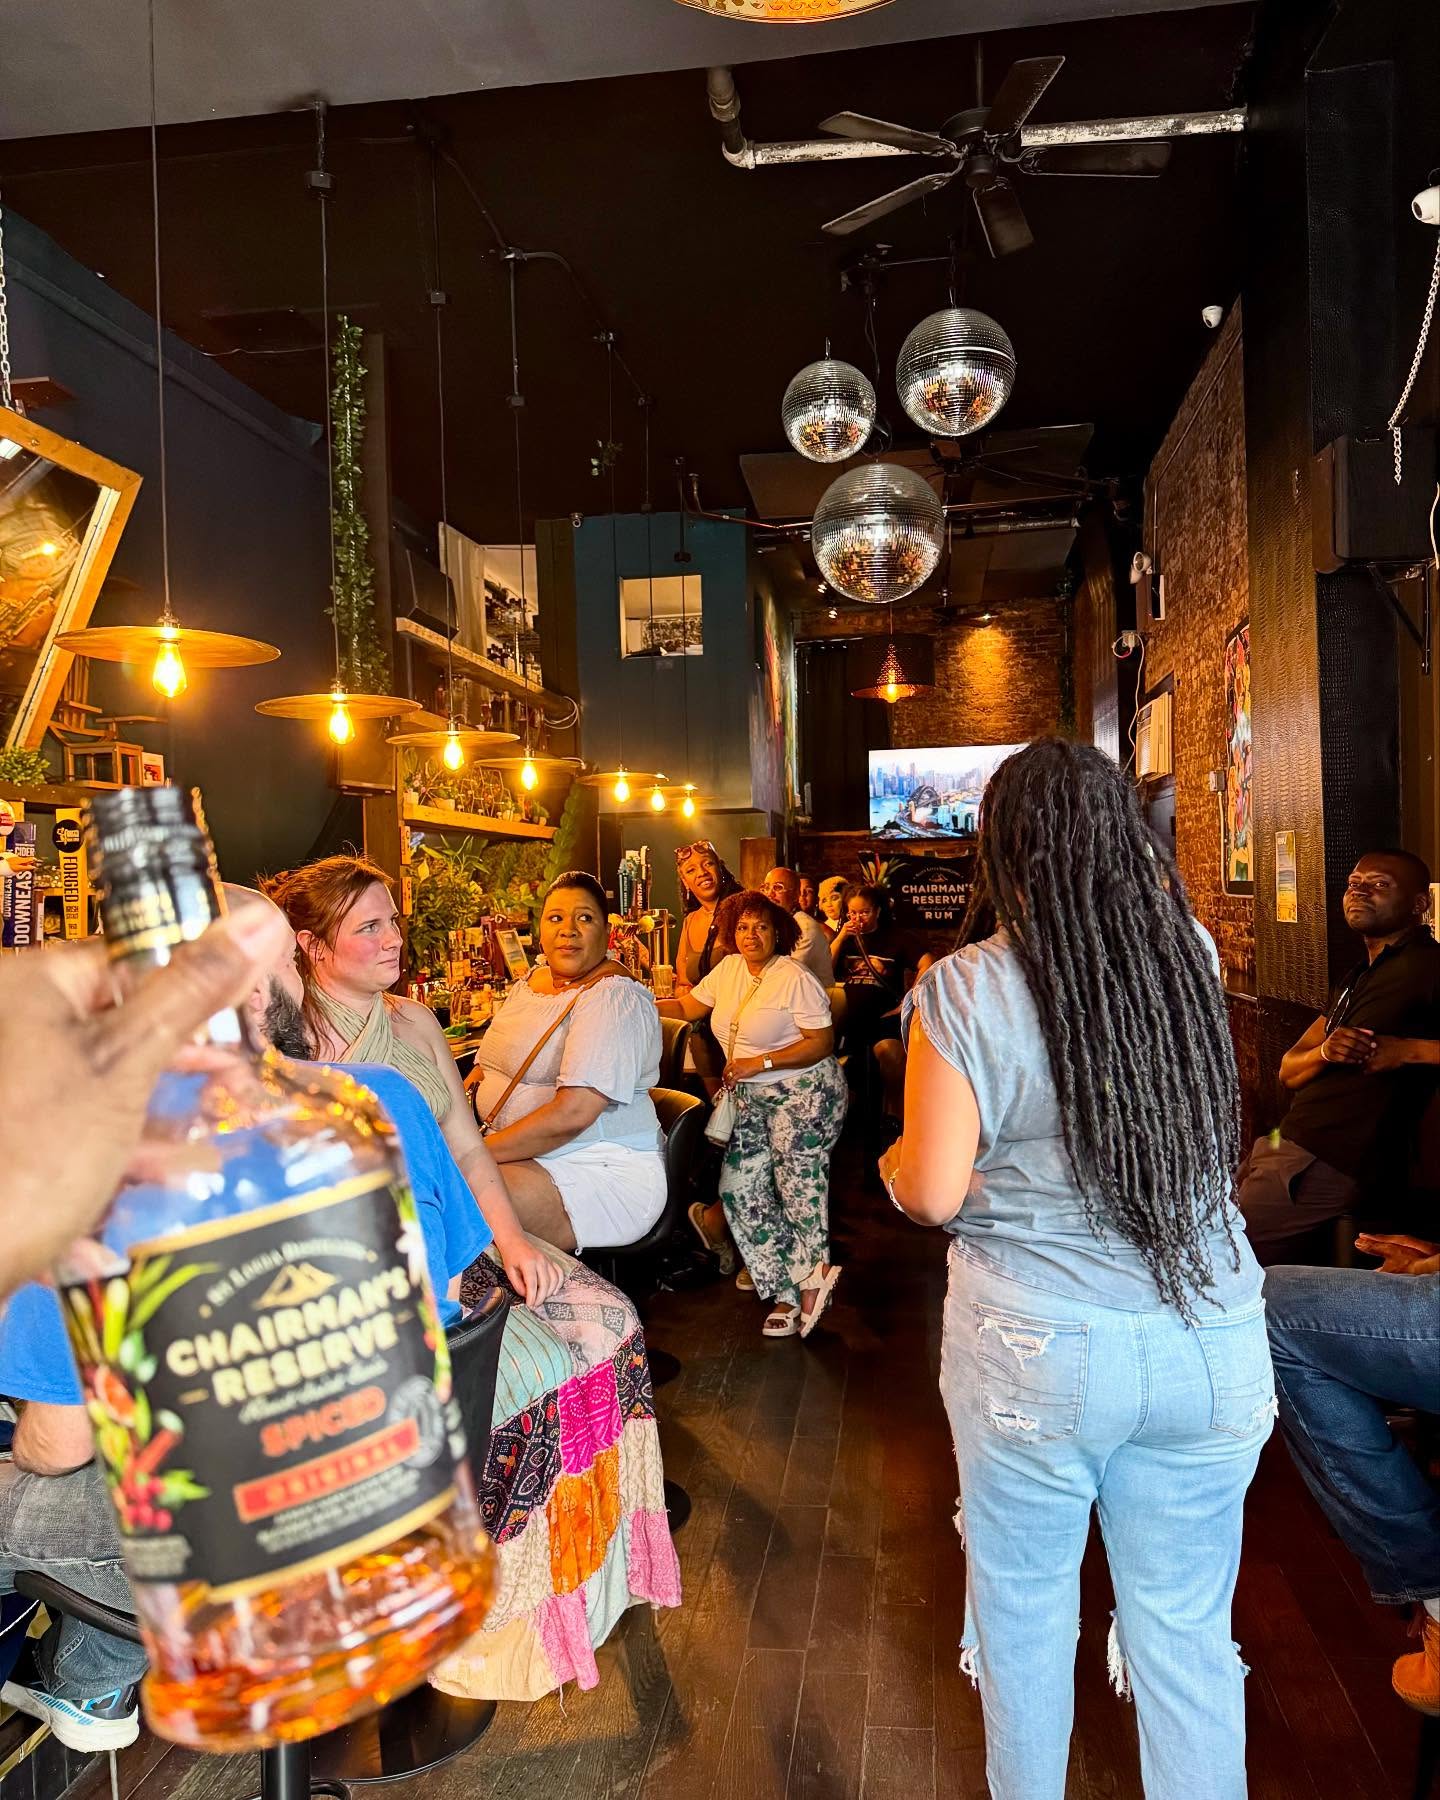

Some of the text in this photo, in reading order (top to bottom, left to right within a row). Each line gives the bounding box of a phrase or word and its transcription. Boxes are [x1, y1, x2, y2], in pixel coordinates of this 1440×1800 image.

[15, 847, 35, 857] CIDER
[63, 857, 79, 902] FORGED
[901, 883, 974, 893] CHAIRMAN'S
[912, 895, 966, 904] RESERVE
[14, 870, 32, 945] DOWNEAS
[925, 911, 953, 919] RUM
[166, 1266, 410, 1376] CHAIRMAN'S
[212, 1312, 399, 1407] RESERVE
[261, 1386, 387, 1457] SPICED
